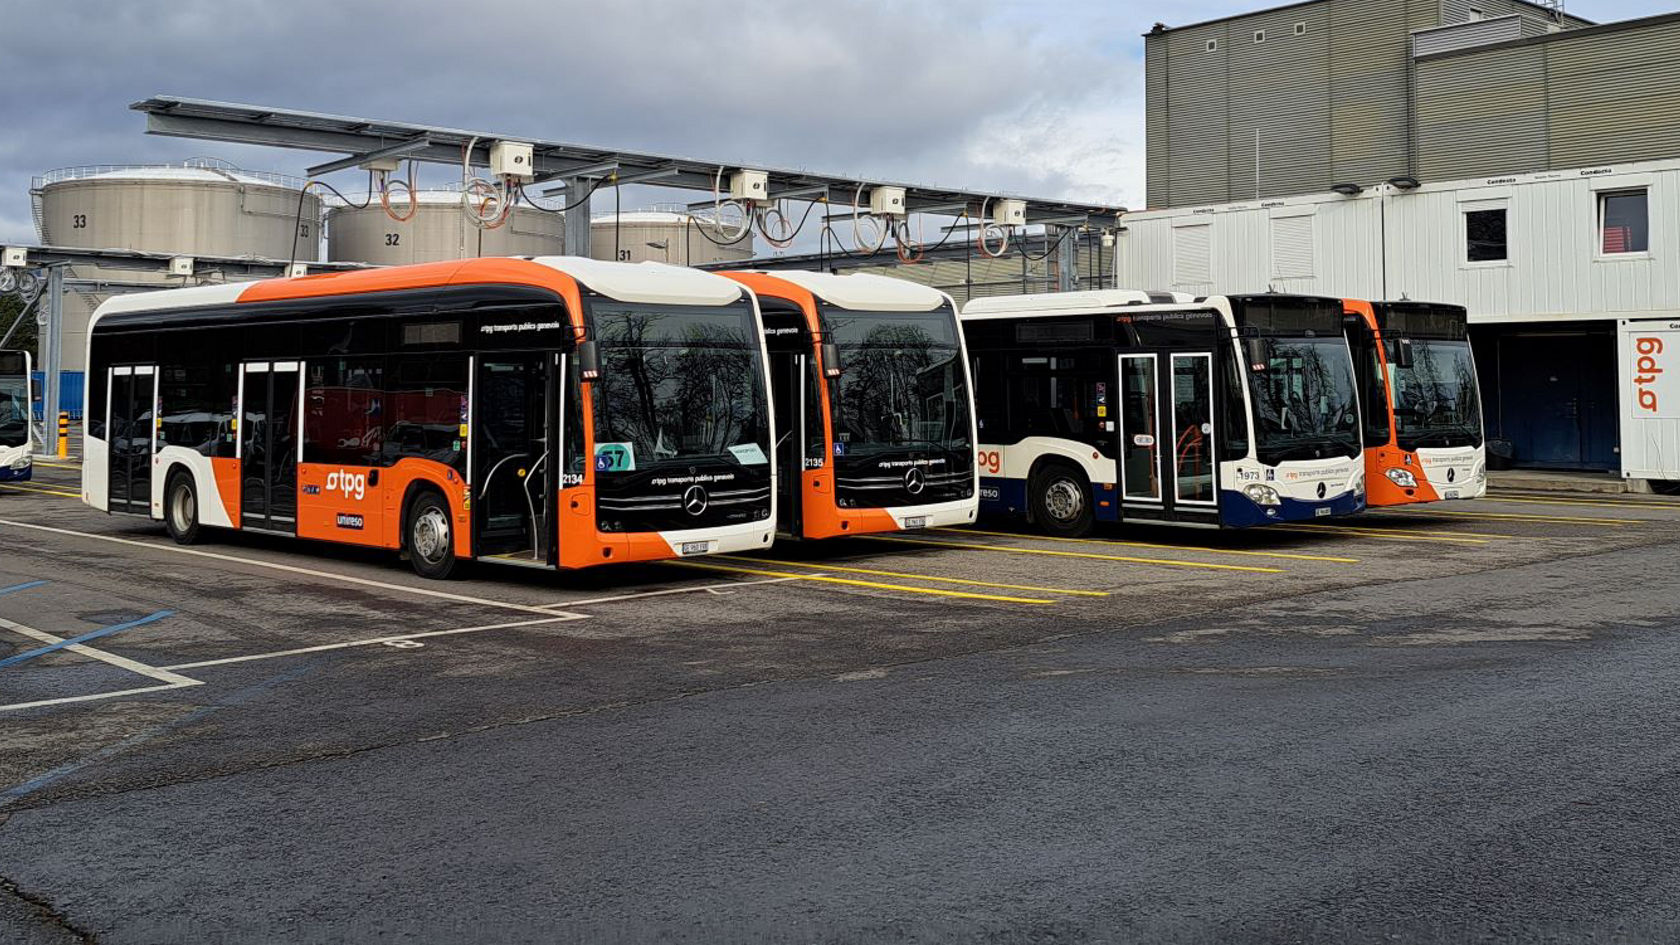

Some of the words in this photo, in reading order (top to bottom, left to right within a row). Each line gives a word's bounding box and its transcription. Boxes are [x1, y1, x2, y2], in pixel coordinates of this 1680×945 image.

[73, 214, 86, 228] 33
[300, 225, 309, 238] 33
[385, 233, 400, 246] 32
[619, 250, 631, 261] 31
[603, 450, 624, 468] 57
[805, 457, 824, 467] 2135
[562, 473, 583, 485] 2134
[1240, 471, 1260, 480] 1973
